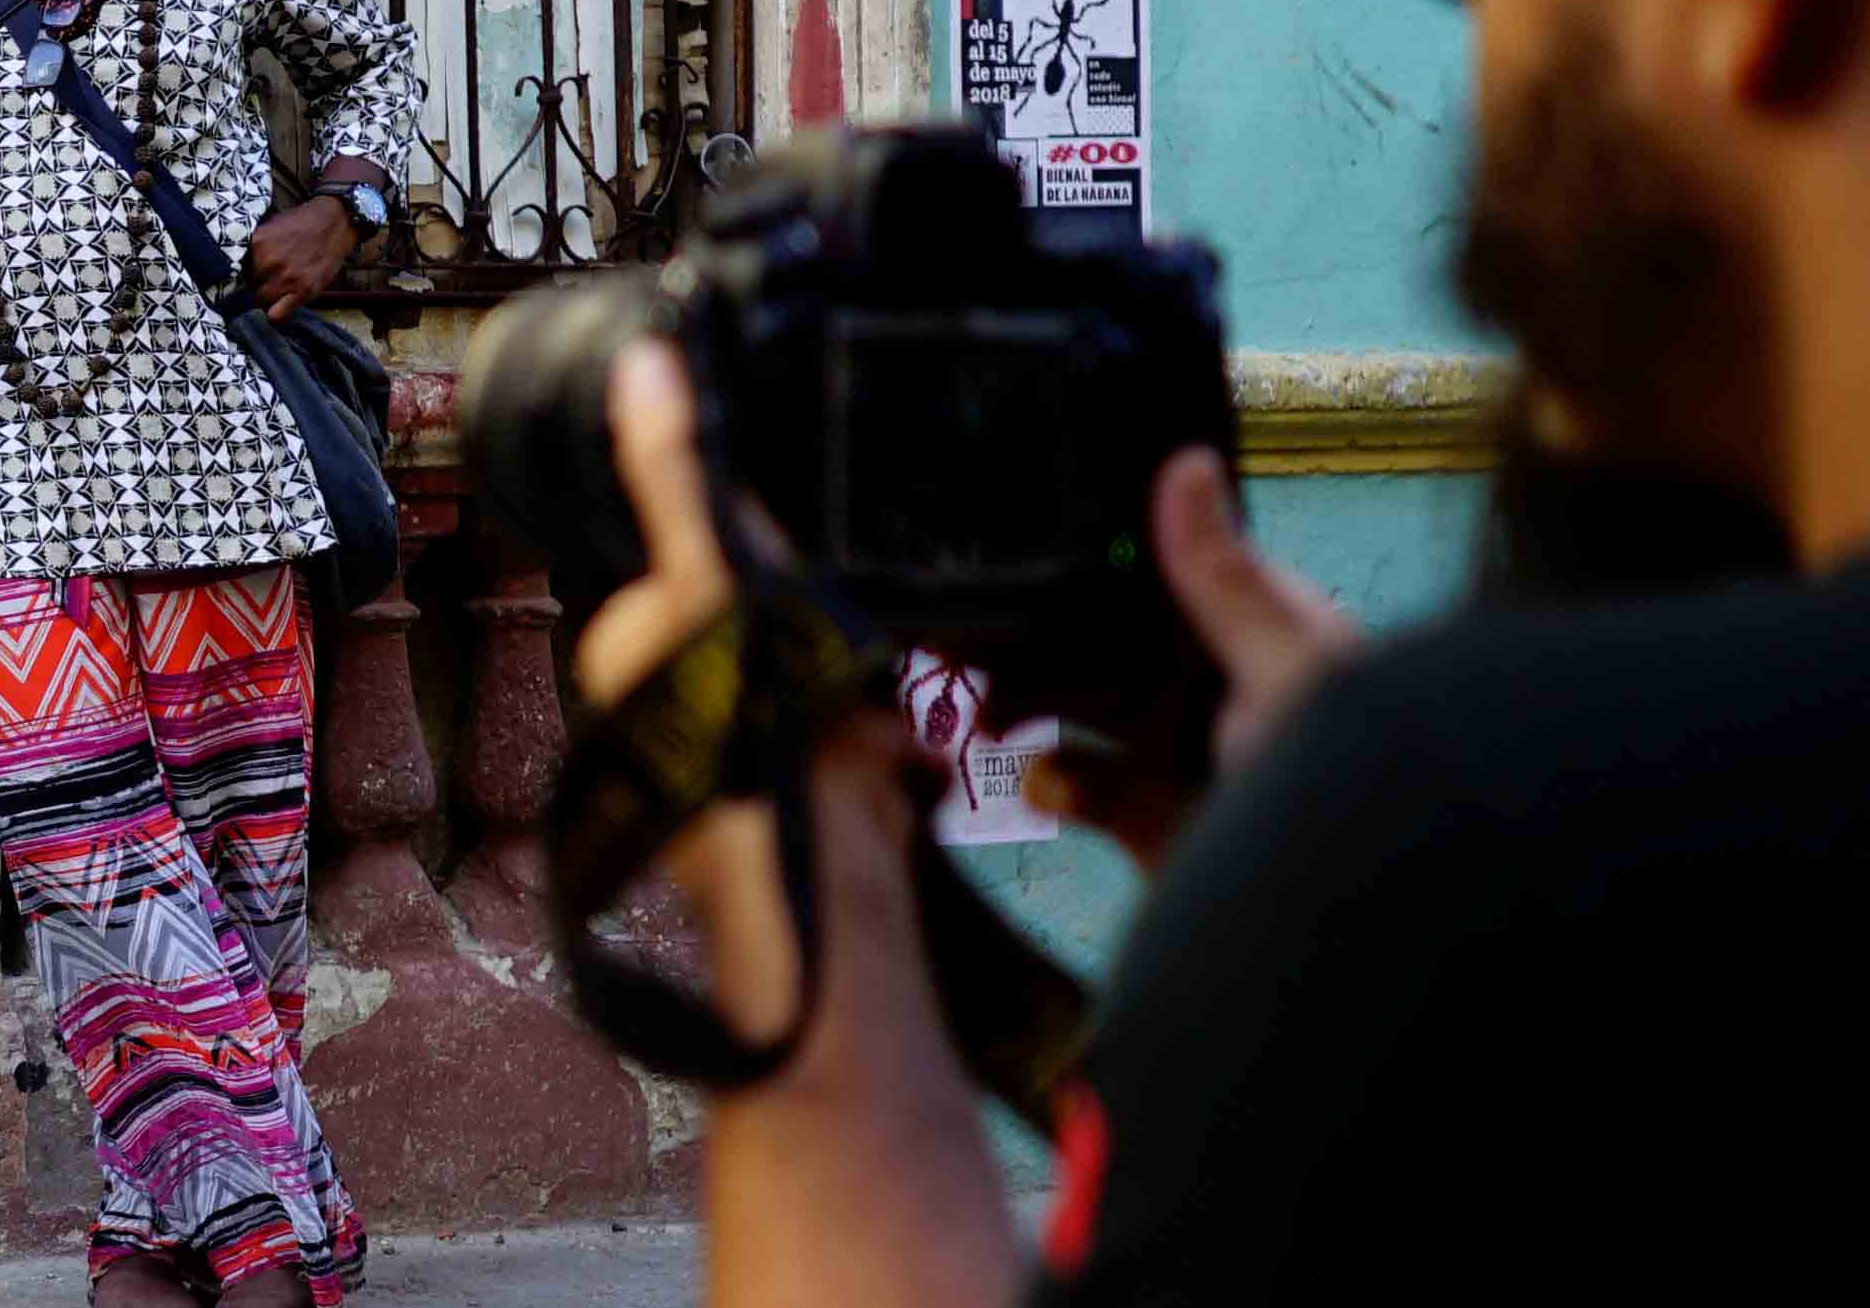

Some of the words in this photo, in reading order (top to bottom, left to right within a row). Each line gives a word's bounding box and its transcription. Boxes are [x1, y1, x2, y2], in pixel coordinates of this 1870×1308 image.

[969, 19, 995, 40] del
[997, 23, 1009, 43] 5
[969, 40, 984, 61] al
[989, 44, 1008, 65] 15
[969, 61, 991, 82] de
[994, 66, 1037, 85] mayo
[970, 83, 1011, 104] 2018
[1046, 187, 1062, 202] DE
[1064, 187, 1080, 202] LA
